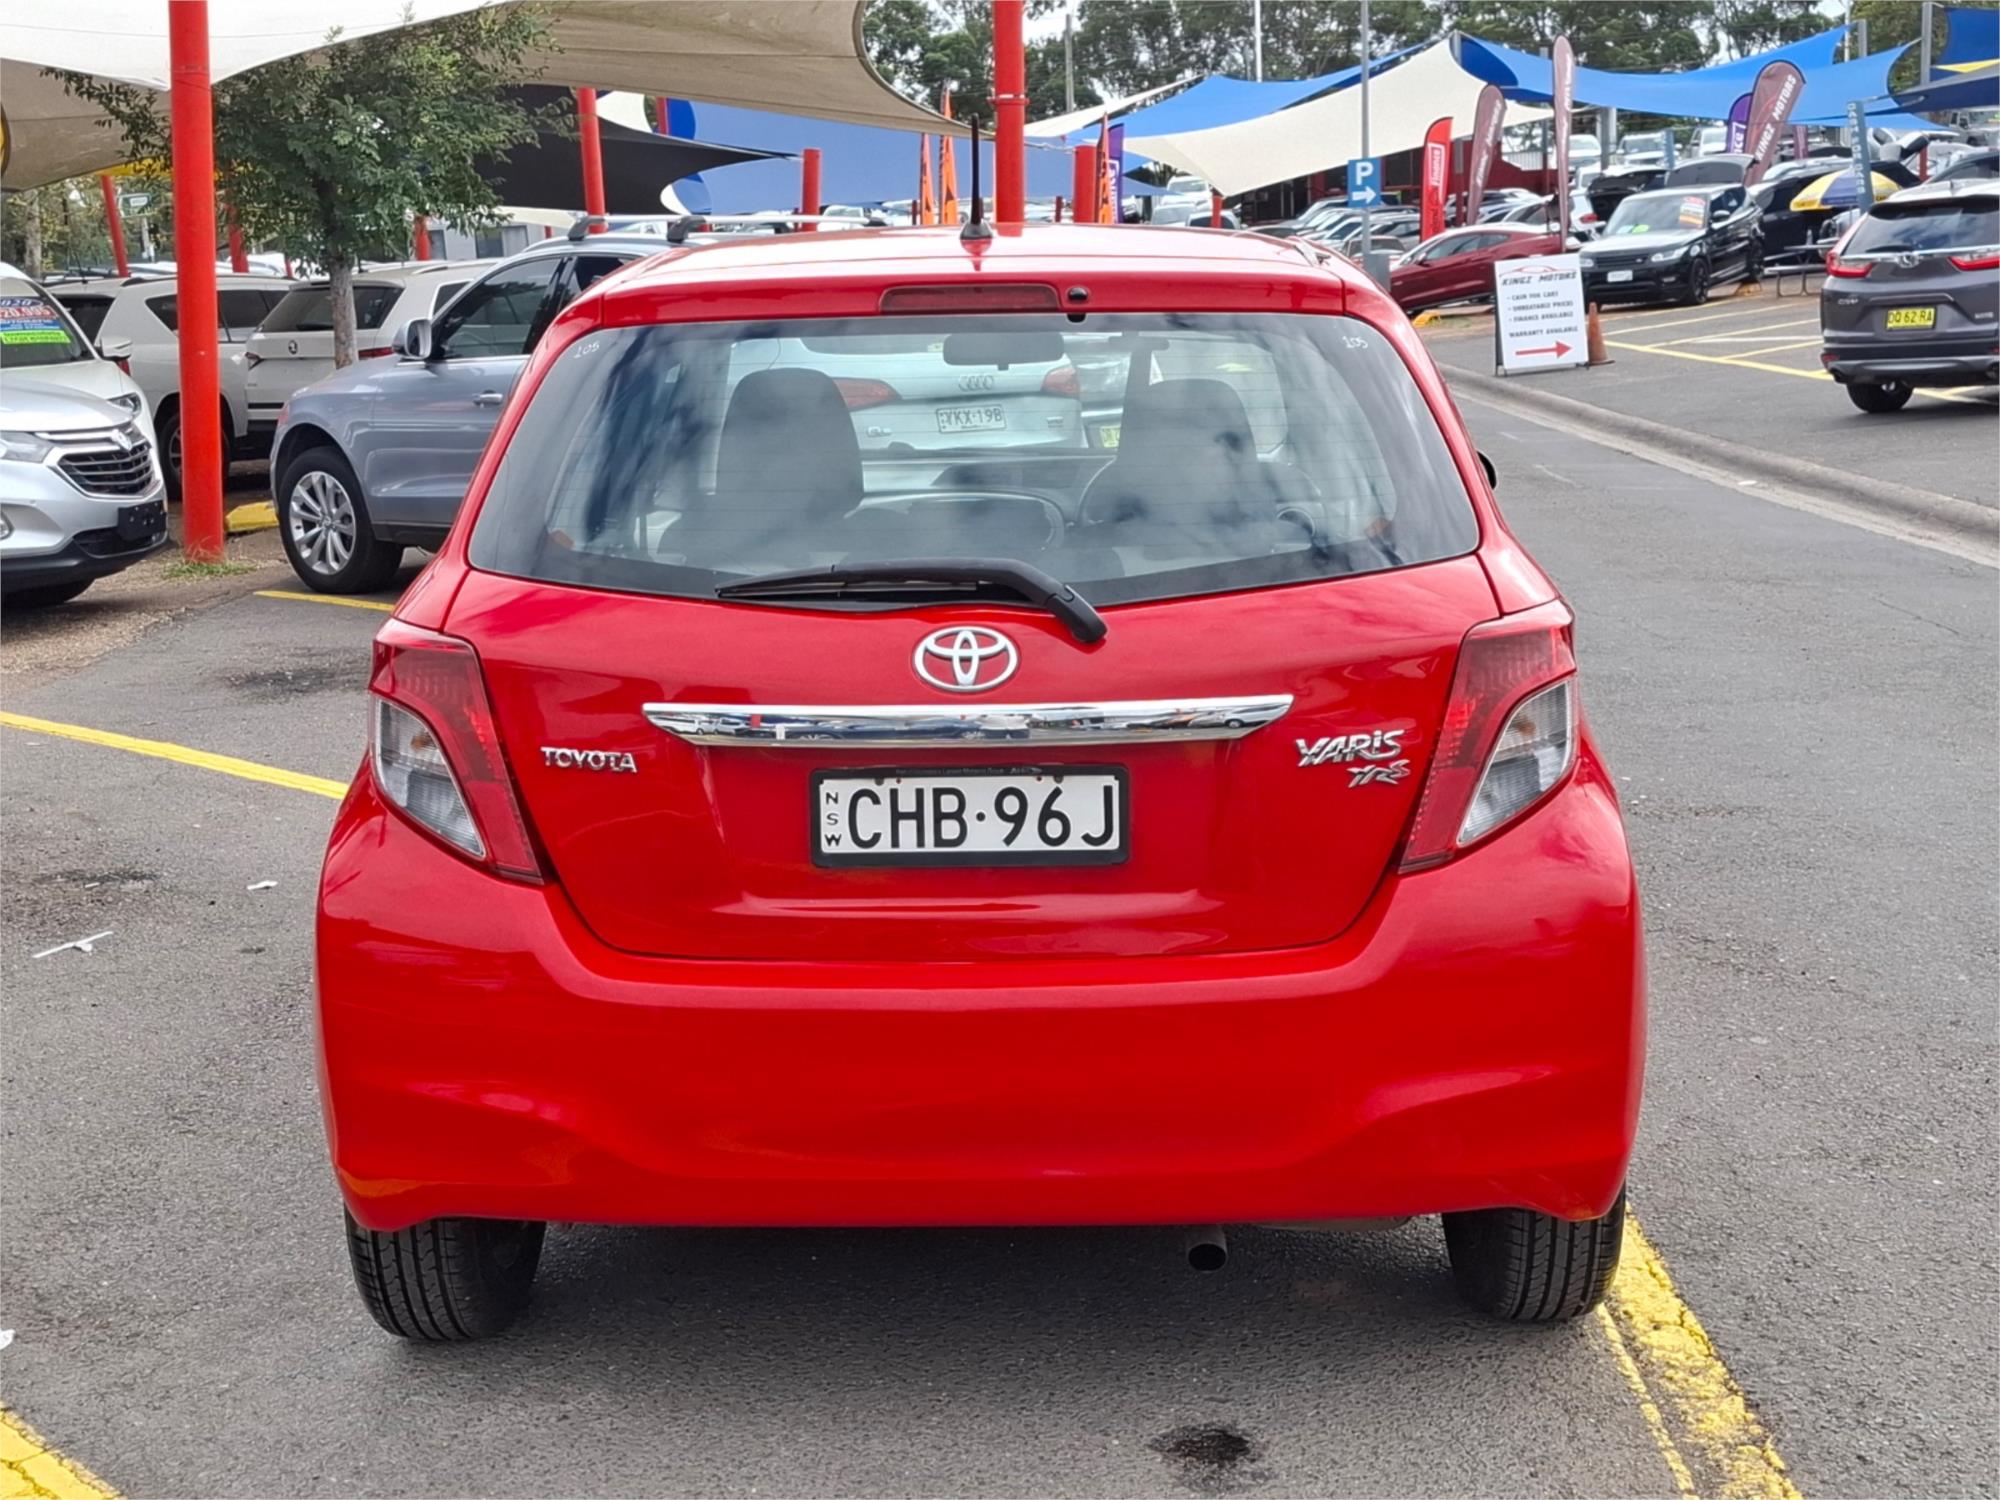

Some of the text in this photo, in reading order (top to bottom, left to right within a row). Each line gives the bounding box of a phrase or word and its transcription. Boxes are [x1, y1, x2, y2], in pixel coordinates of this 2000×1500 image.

[1771, 73, 1797, 121] MOTORS
[1356, 161, 1374, 186] P
[1502, 271, 1578, 286] KINGZ MOTORS
[540, 746, 637, 773] TOYOTA
